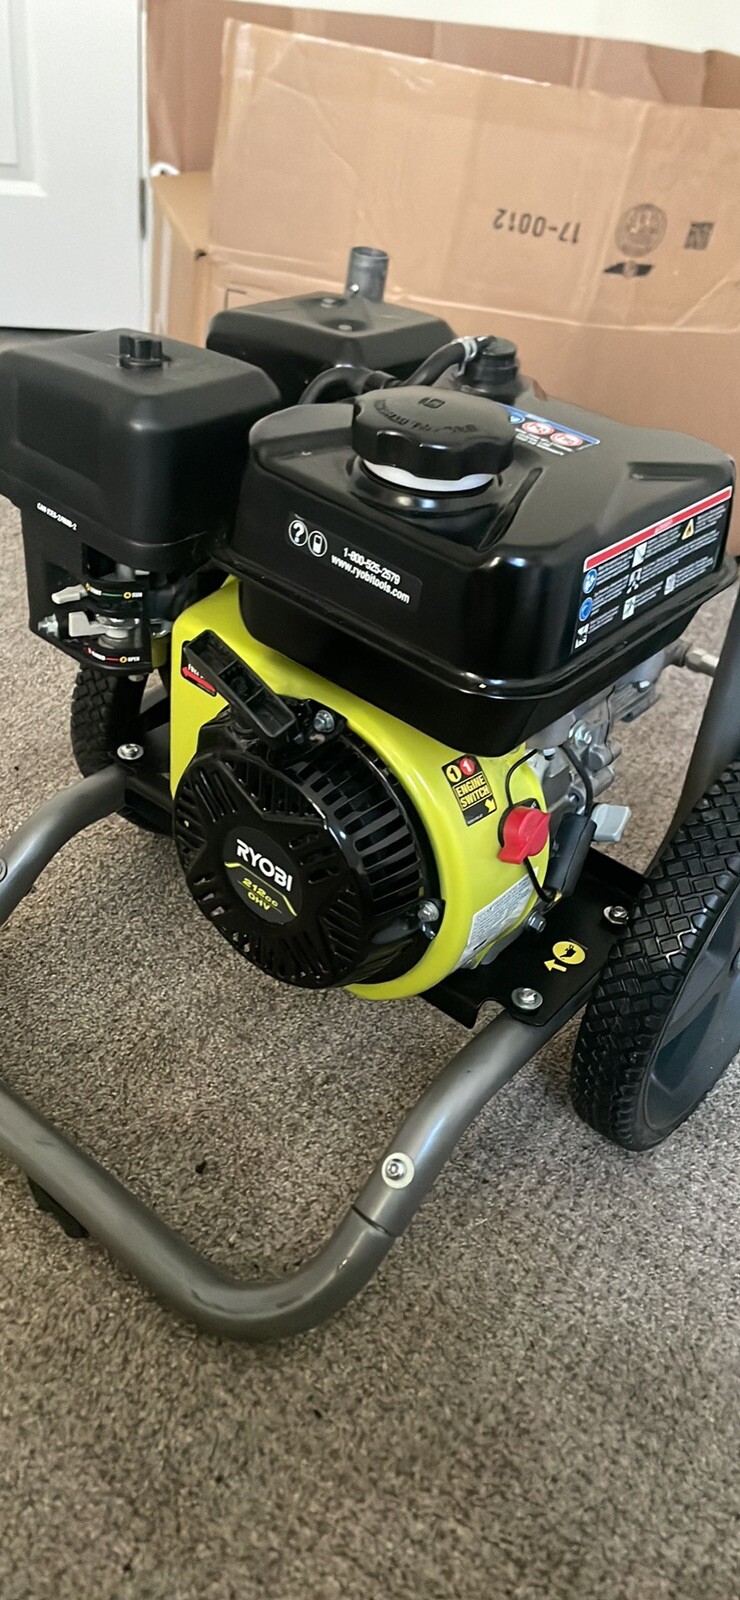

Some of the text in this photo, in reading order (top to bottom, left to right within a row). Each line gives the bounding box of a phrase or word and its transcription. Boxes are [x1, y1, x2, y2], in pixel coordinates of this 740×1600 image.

[492, 208, 581, 244] 17-0012
[331, 555, 410, 604] www.ryobitools.com
[343, 547, 401, 585] 1-800-525-2579
[449, 760, 472, 780] 1 1
[455, 775, 486, 798] ENGINE
[460, 785, 490, 809] SWITCH
[236, 838, 293, 892] RYOBI
[247, 891, 271, 911] OHV
